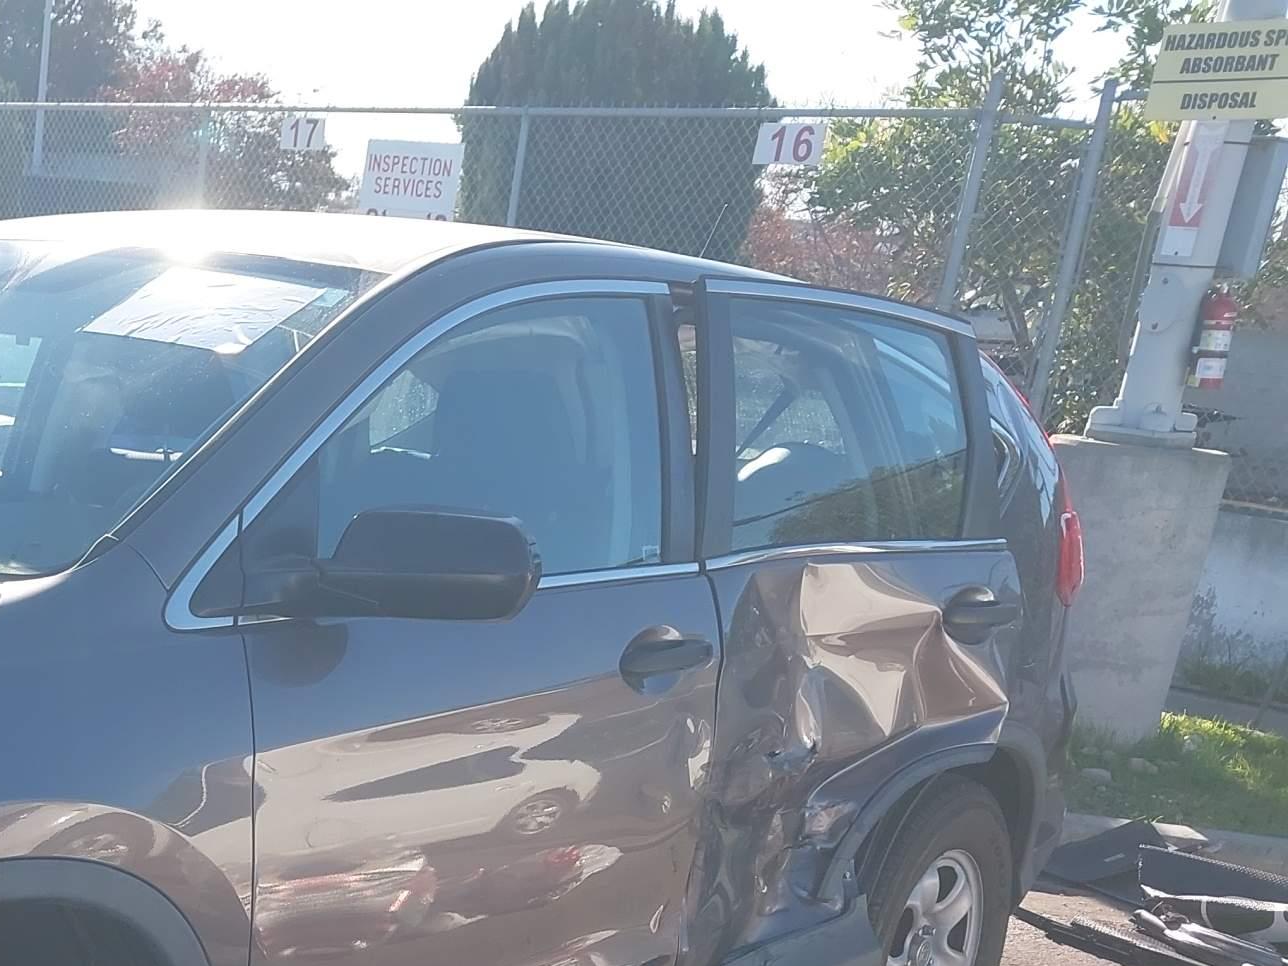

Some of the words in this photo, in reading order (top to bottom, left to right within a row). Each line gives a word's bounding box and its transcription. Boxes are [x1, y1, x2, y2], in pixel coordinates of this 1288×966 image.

[1164, 30, 1262, 51] HAZARDOUS
[1179, 54, 1280, 74] ABSORBANT
[1180, 91, 1257, 110] DISPOSAL
[290, 119, 320, 148] 17
[771, 125, 815, 162] 16
[368, 153, 453, 176] INSPECTION
[374, 176, 442, 199] SERVICES
